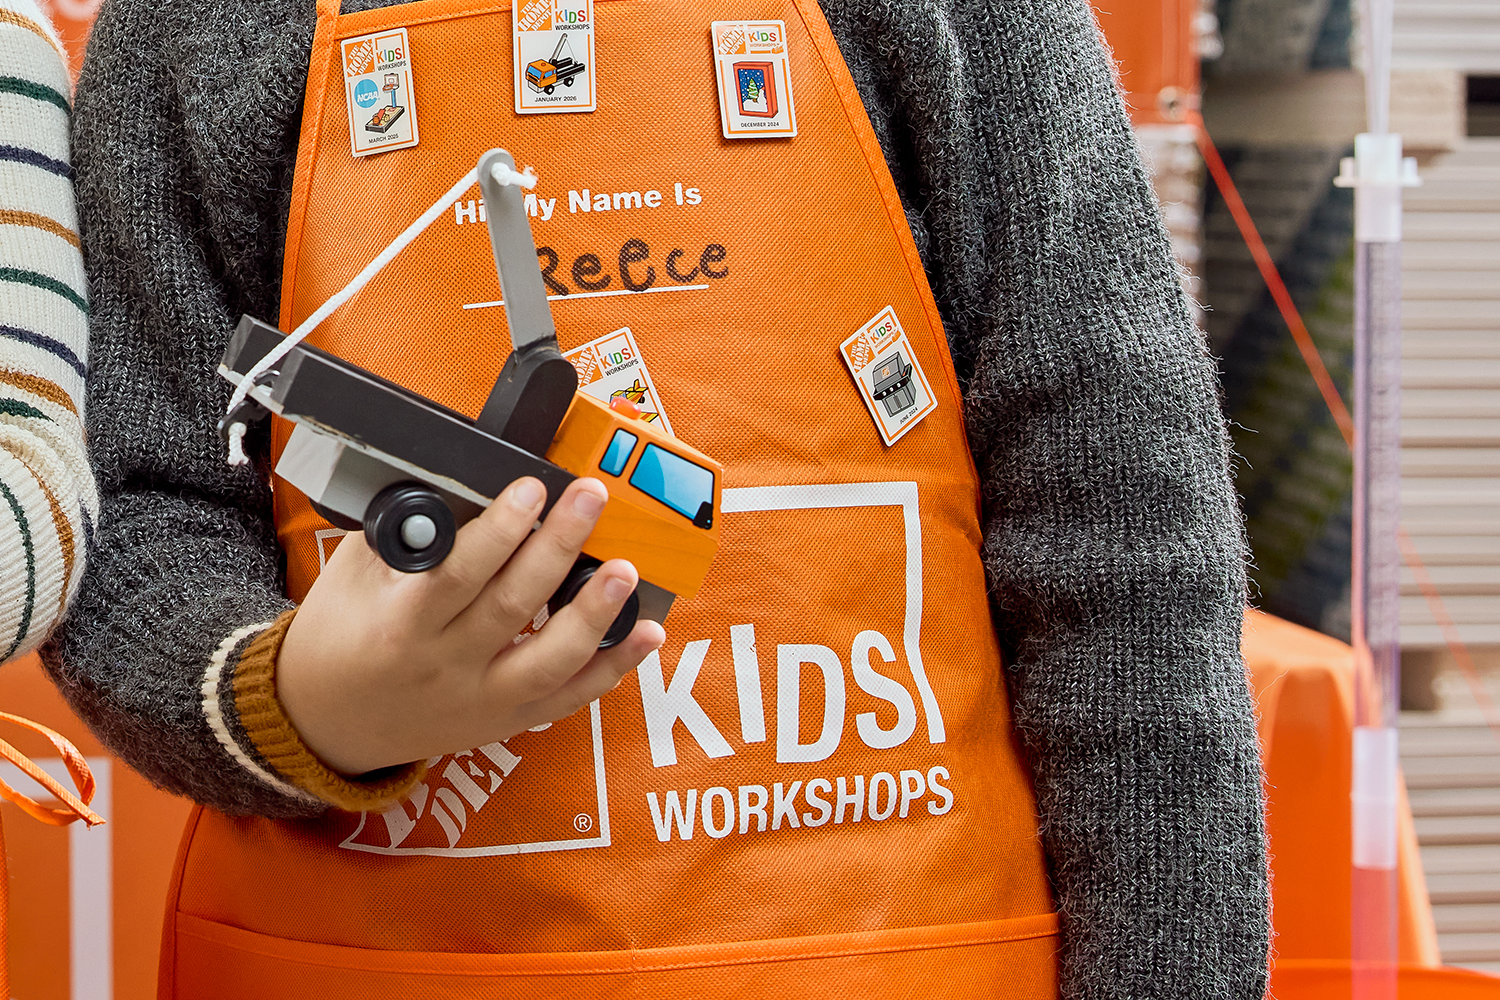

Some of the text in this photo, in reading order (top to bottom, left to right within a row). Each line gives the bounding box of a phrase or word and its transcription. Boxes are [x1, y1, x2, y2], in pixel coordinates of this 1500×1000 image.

[520, 0, 536, 15] THE
[555, 9, 586, 23] KIDS
[531, 9, 552, 31] DEPOT
[555, 23, 590, 31] WORKSHOPS
[748, 31, 777, 42] KIDS
[346, 39, 374, 76] HOME
[348, 45, 359, 60] THE
[357, 51, 374, 75] DEPOT
[376, 47, 403, 64] KIDS
[377, 60, 407, 71] WORKSHOPS
[357, 90, 379, 103] NCAA
[368, 133, 399, 144] MARCH 2025
[568, 188, 663, 214] Name
[674, 182, 702, 206] Is
[870, 322, 892, 344] KIDS
[600, 348, 632, 369] KIDS
[853, 333, 866, 371] HOME
[576, 348, 594, 384] OME
[583, 359, 598, 385] DEPOT
[605, 358, 639, 377] WORKSHOPS
[636, 623, 917, 768] KIDS
[646, 765, 954, 842] WORKSHOPS
